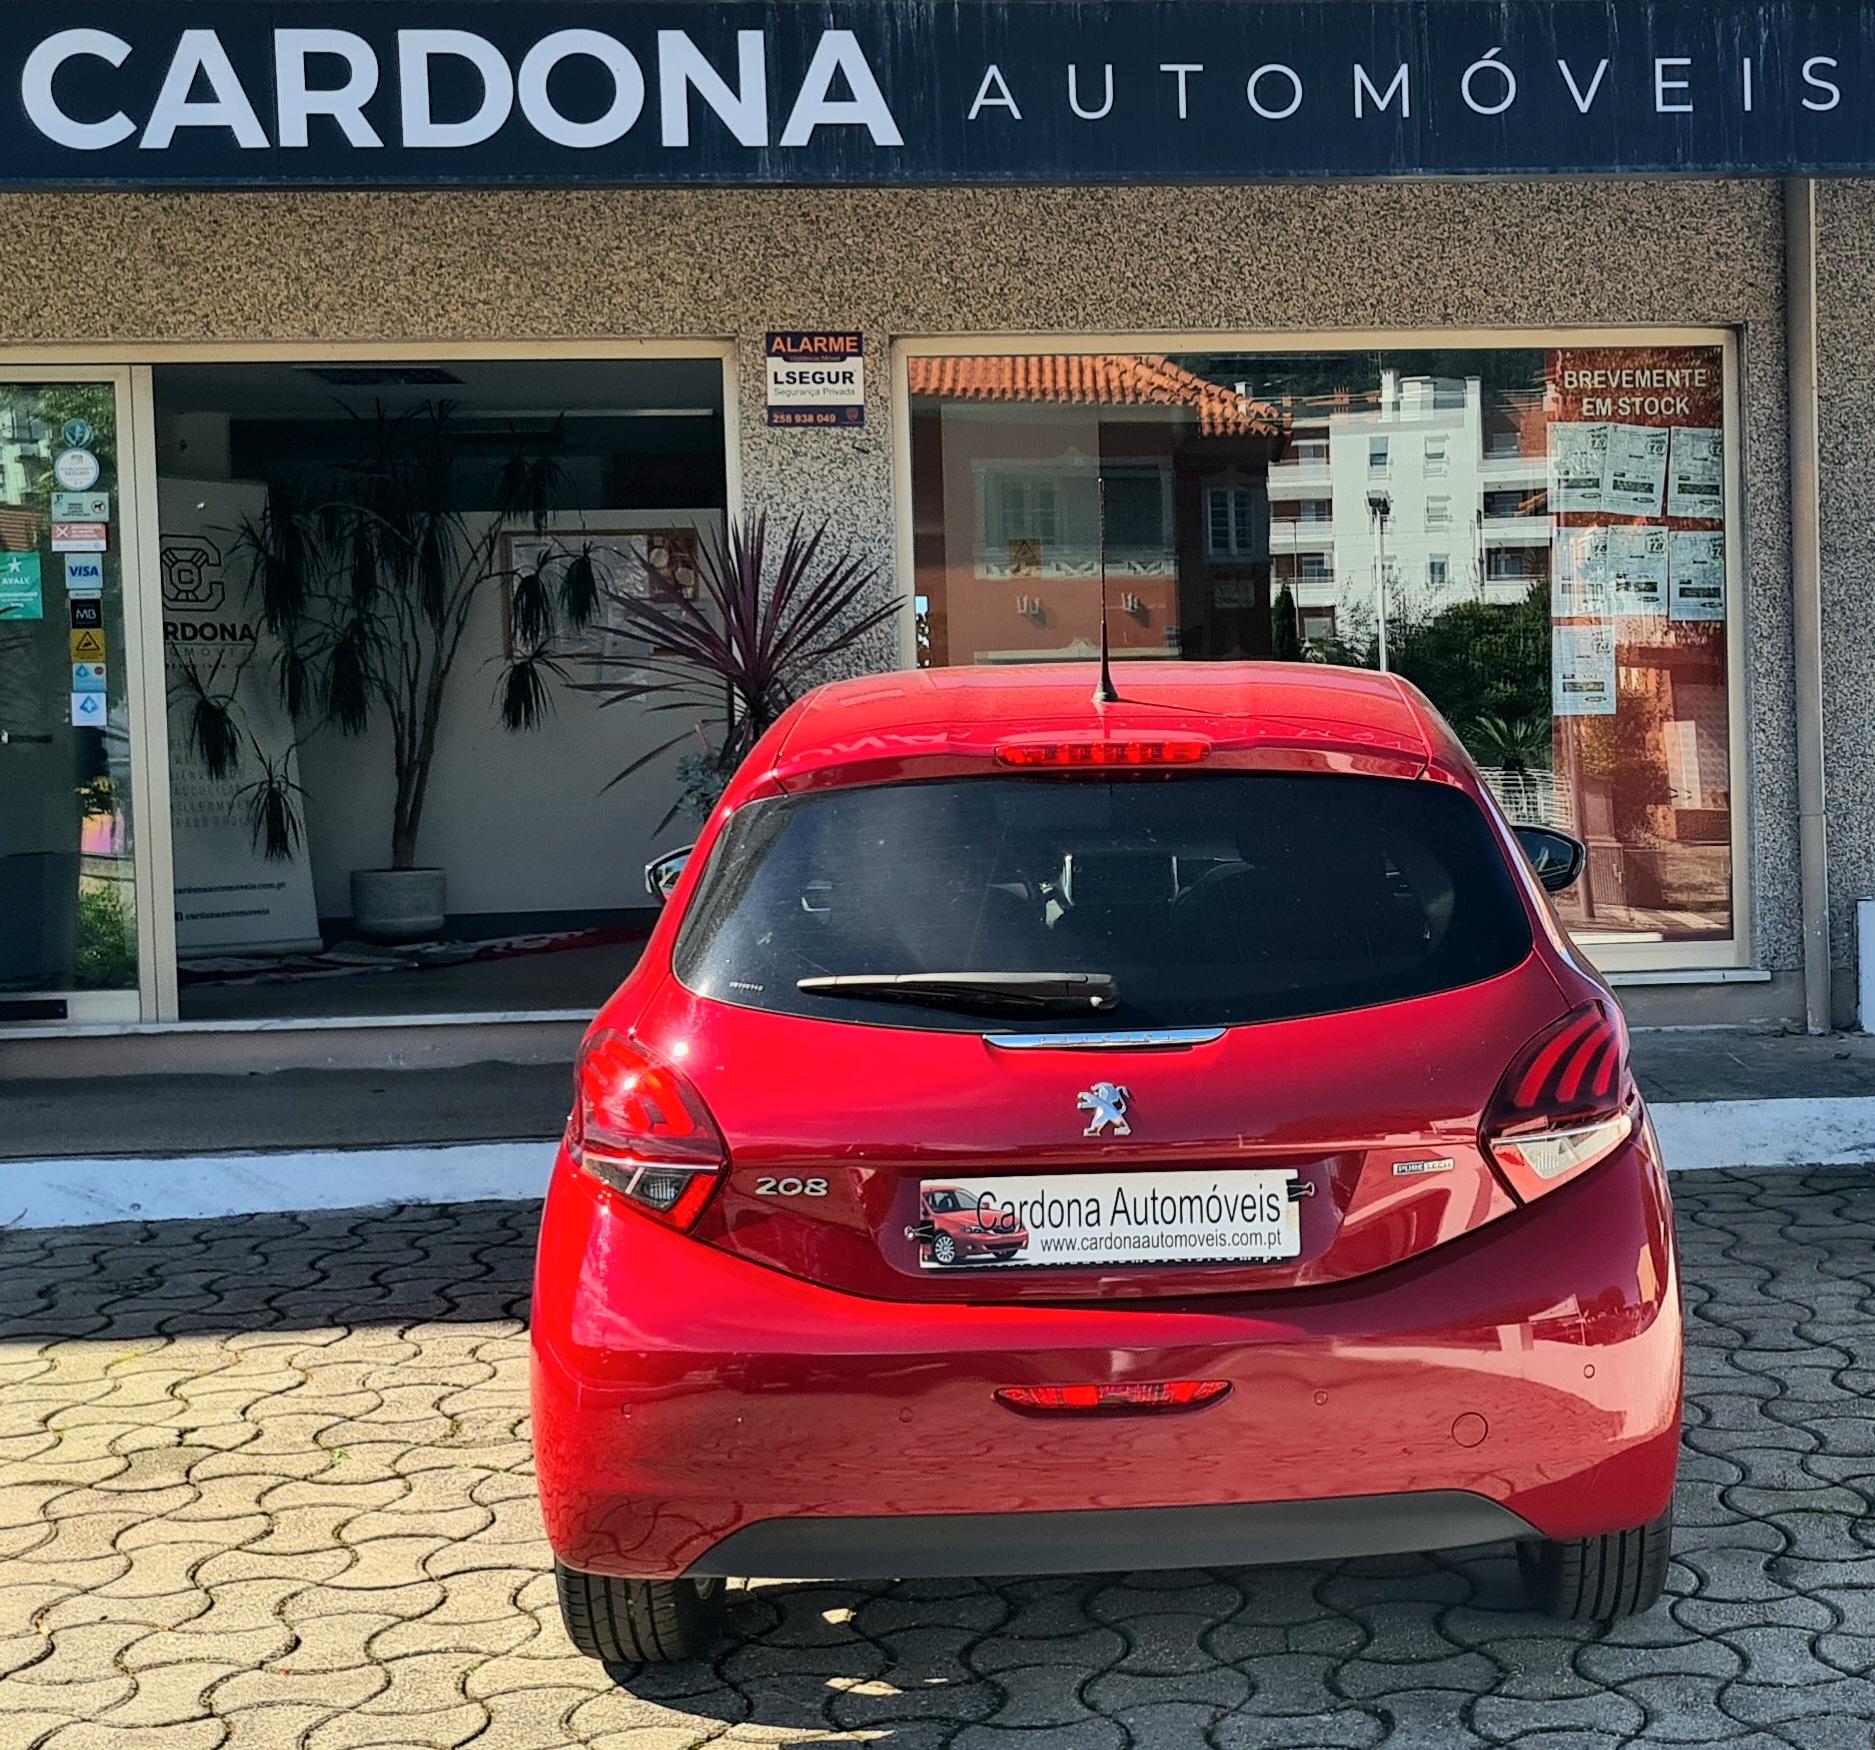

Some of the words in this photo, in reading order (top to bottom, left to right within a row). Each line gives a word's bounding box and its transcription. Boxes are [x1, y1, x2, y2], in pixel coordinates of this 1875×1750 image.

[21, 28, 904, 150] CARDONA
[967, 48, 1842, 121] AUTOMÓVEIS
[771, 336, 859, 352] ALARME
[773, 371, 855, 385] LSEGUR
[1564, 369, 1707, 389] BREVEMENTE
[774, 388, 820, 397] Segurança
[823, 387, 855, 396] Privada
[1583, 398, 1612, 416] EM
[1617, 396, 1690, 416] STOCK
[69, 565, 100, 577] VISA
[76, 609, 97, 620] MB
[755, 1177, 829, 1197] 208
[976, 1189, 1101, 1231] Cardona
[1109, 1185, 1282, 1228] Automóveis
[1040, 1229, 1283, 1253] www.cardonaautomoveis.com.pt
